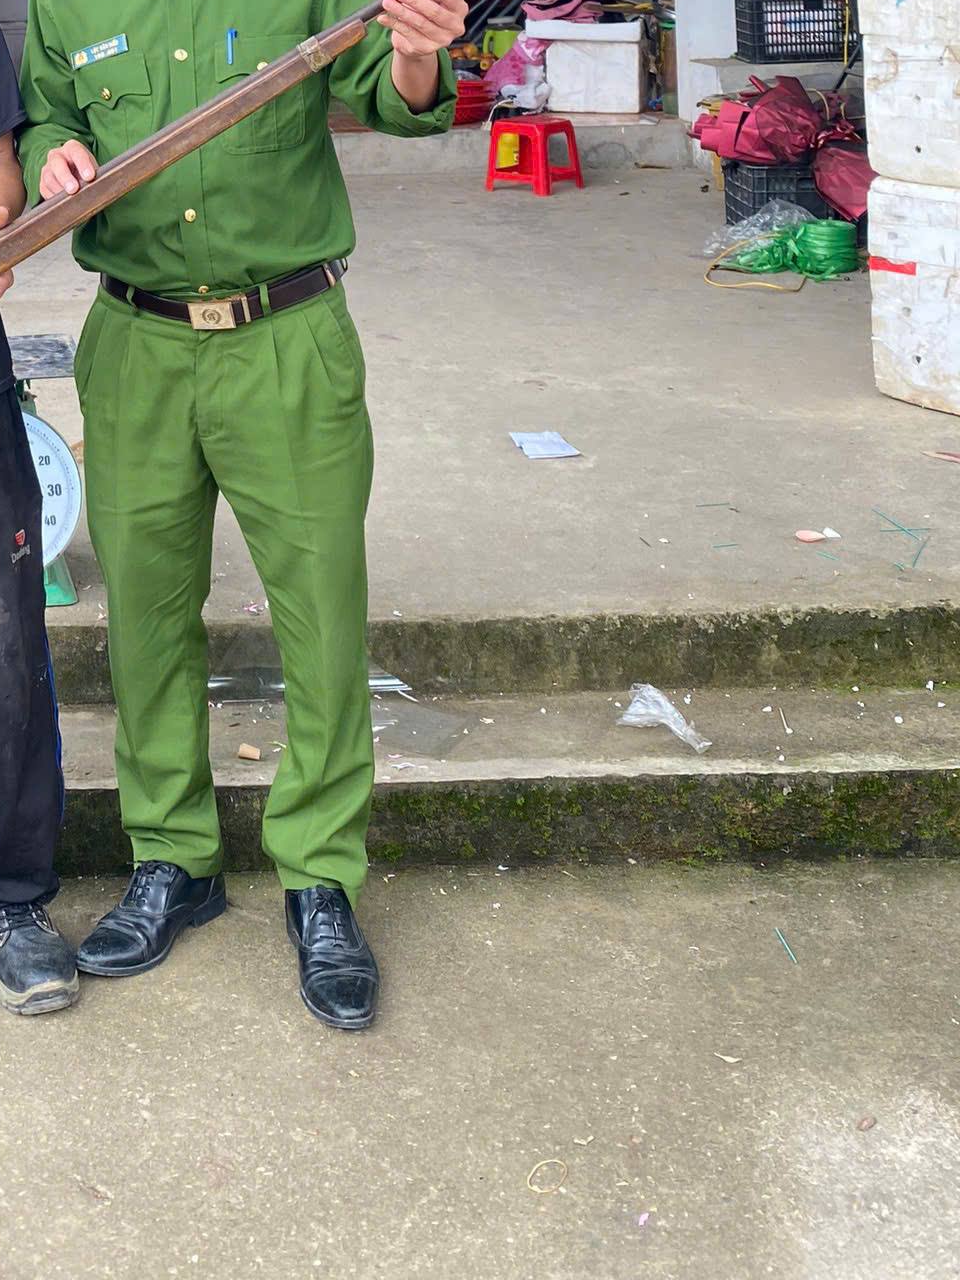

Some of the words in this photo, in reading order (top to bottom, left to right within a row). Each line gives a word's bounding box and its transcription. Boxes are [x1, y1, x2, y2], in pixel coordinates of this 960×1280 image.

[39, 455, 50, 466] 20
[47, 484, 62, 496] 30
[44, 515, 56, 526] 40
